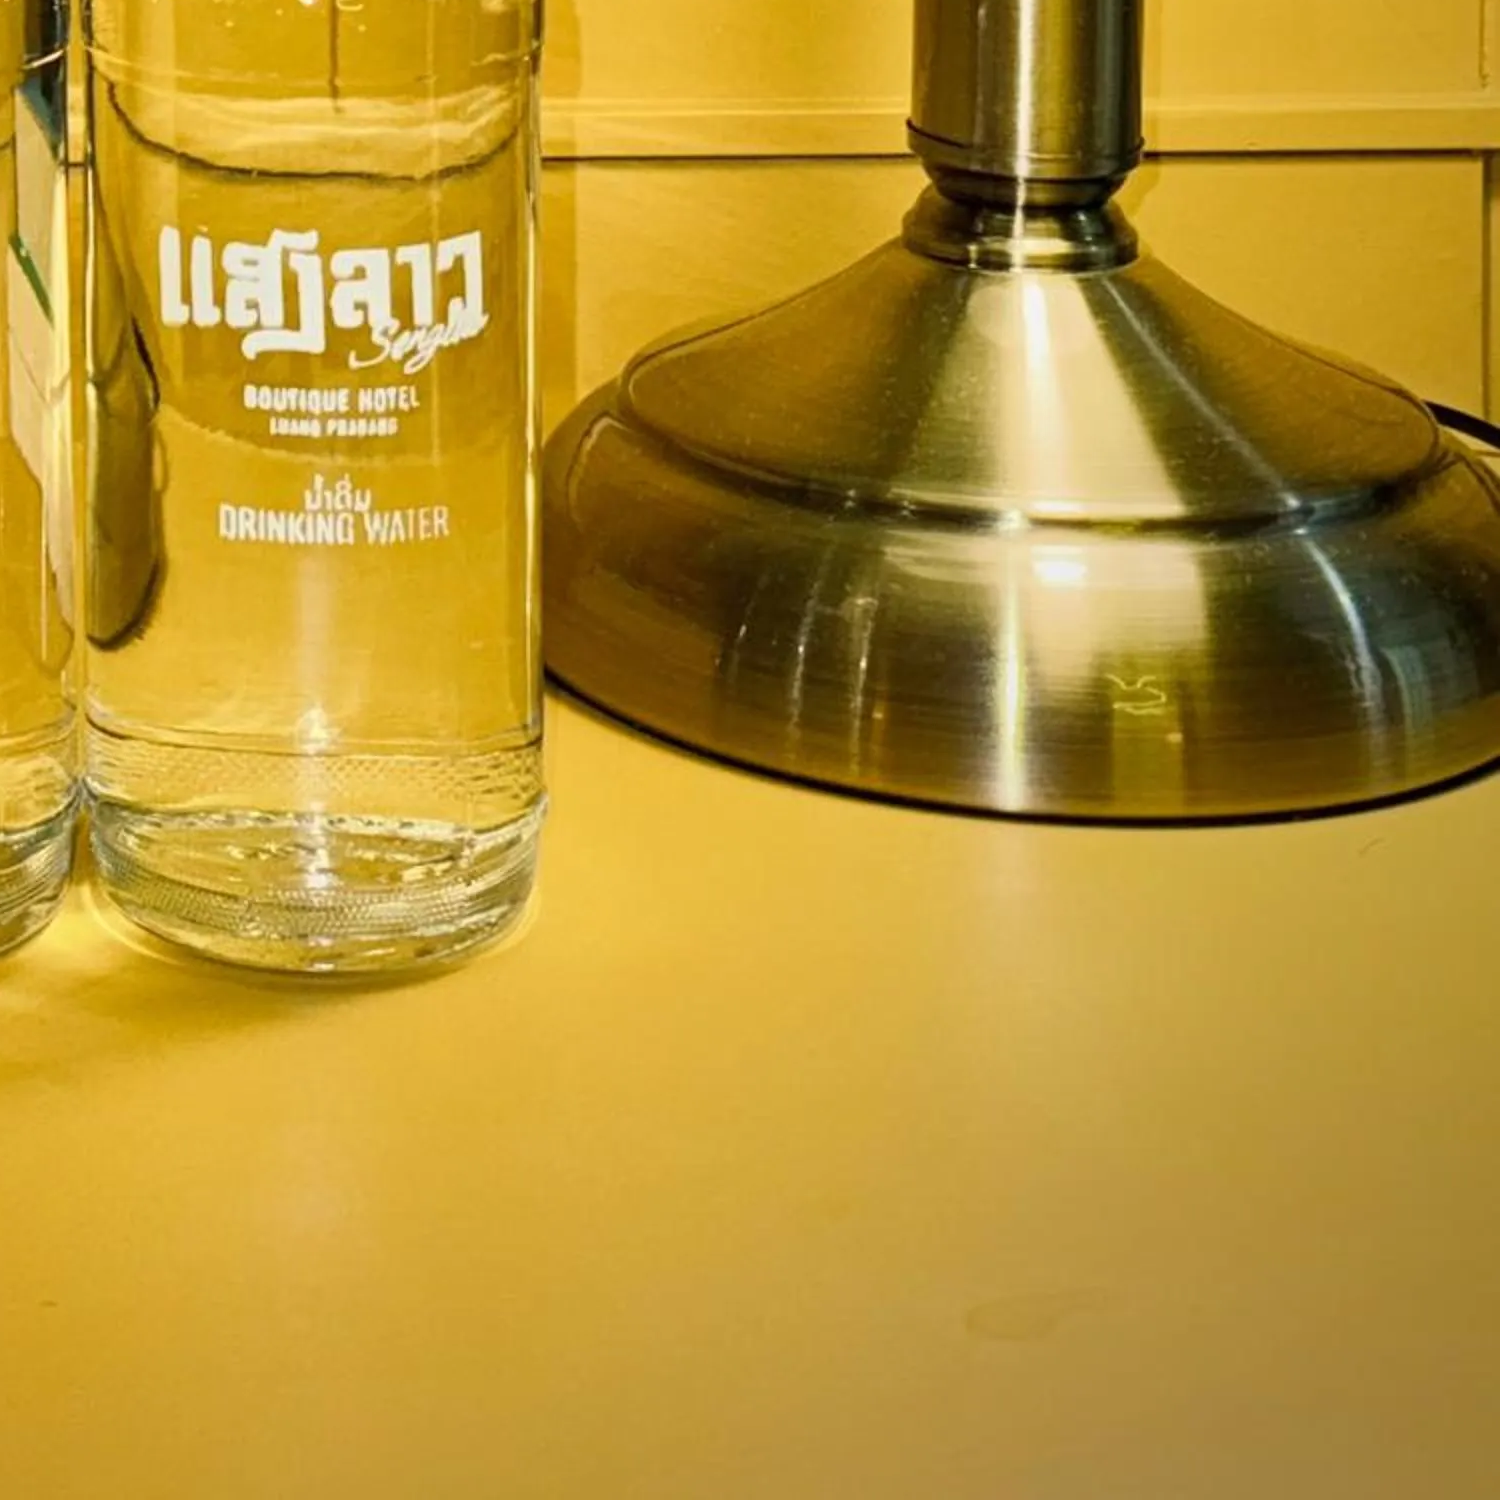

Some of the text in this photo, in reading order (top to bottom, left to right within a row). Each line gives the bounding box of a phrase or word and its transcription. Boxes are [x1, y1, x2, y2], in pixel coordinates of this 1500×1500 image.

[243, 383, 420, 414] BOUTIQUE HOTEL
[218, 502, 450, 546] DRINKING WATER
